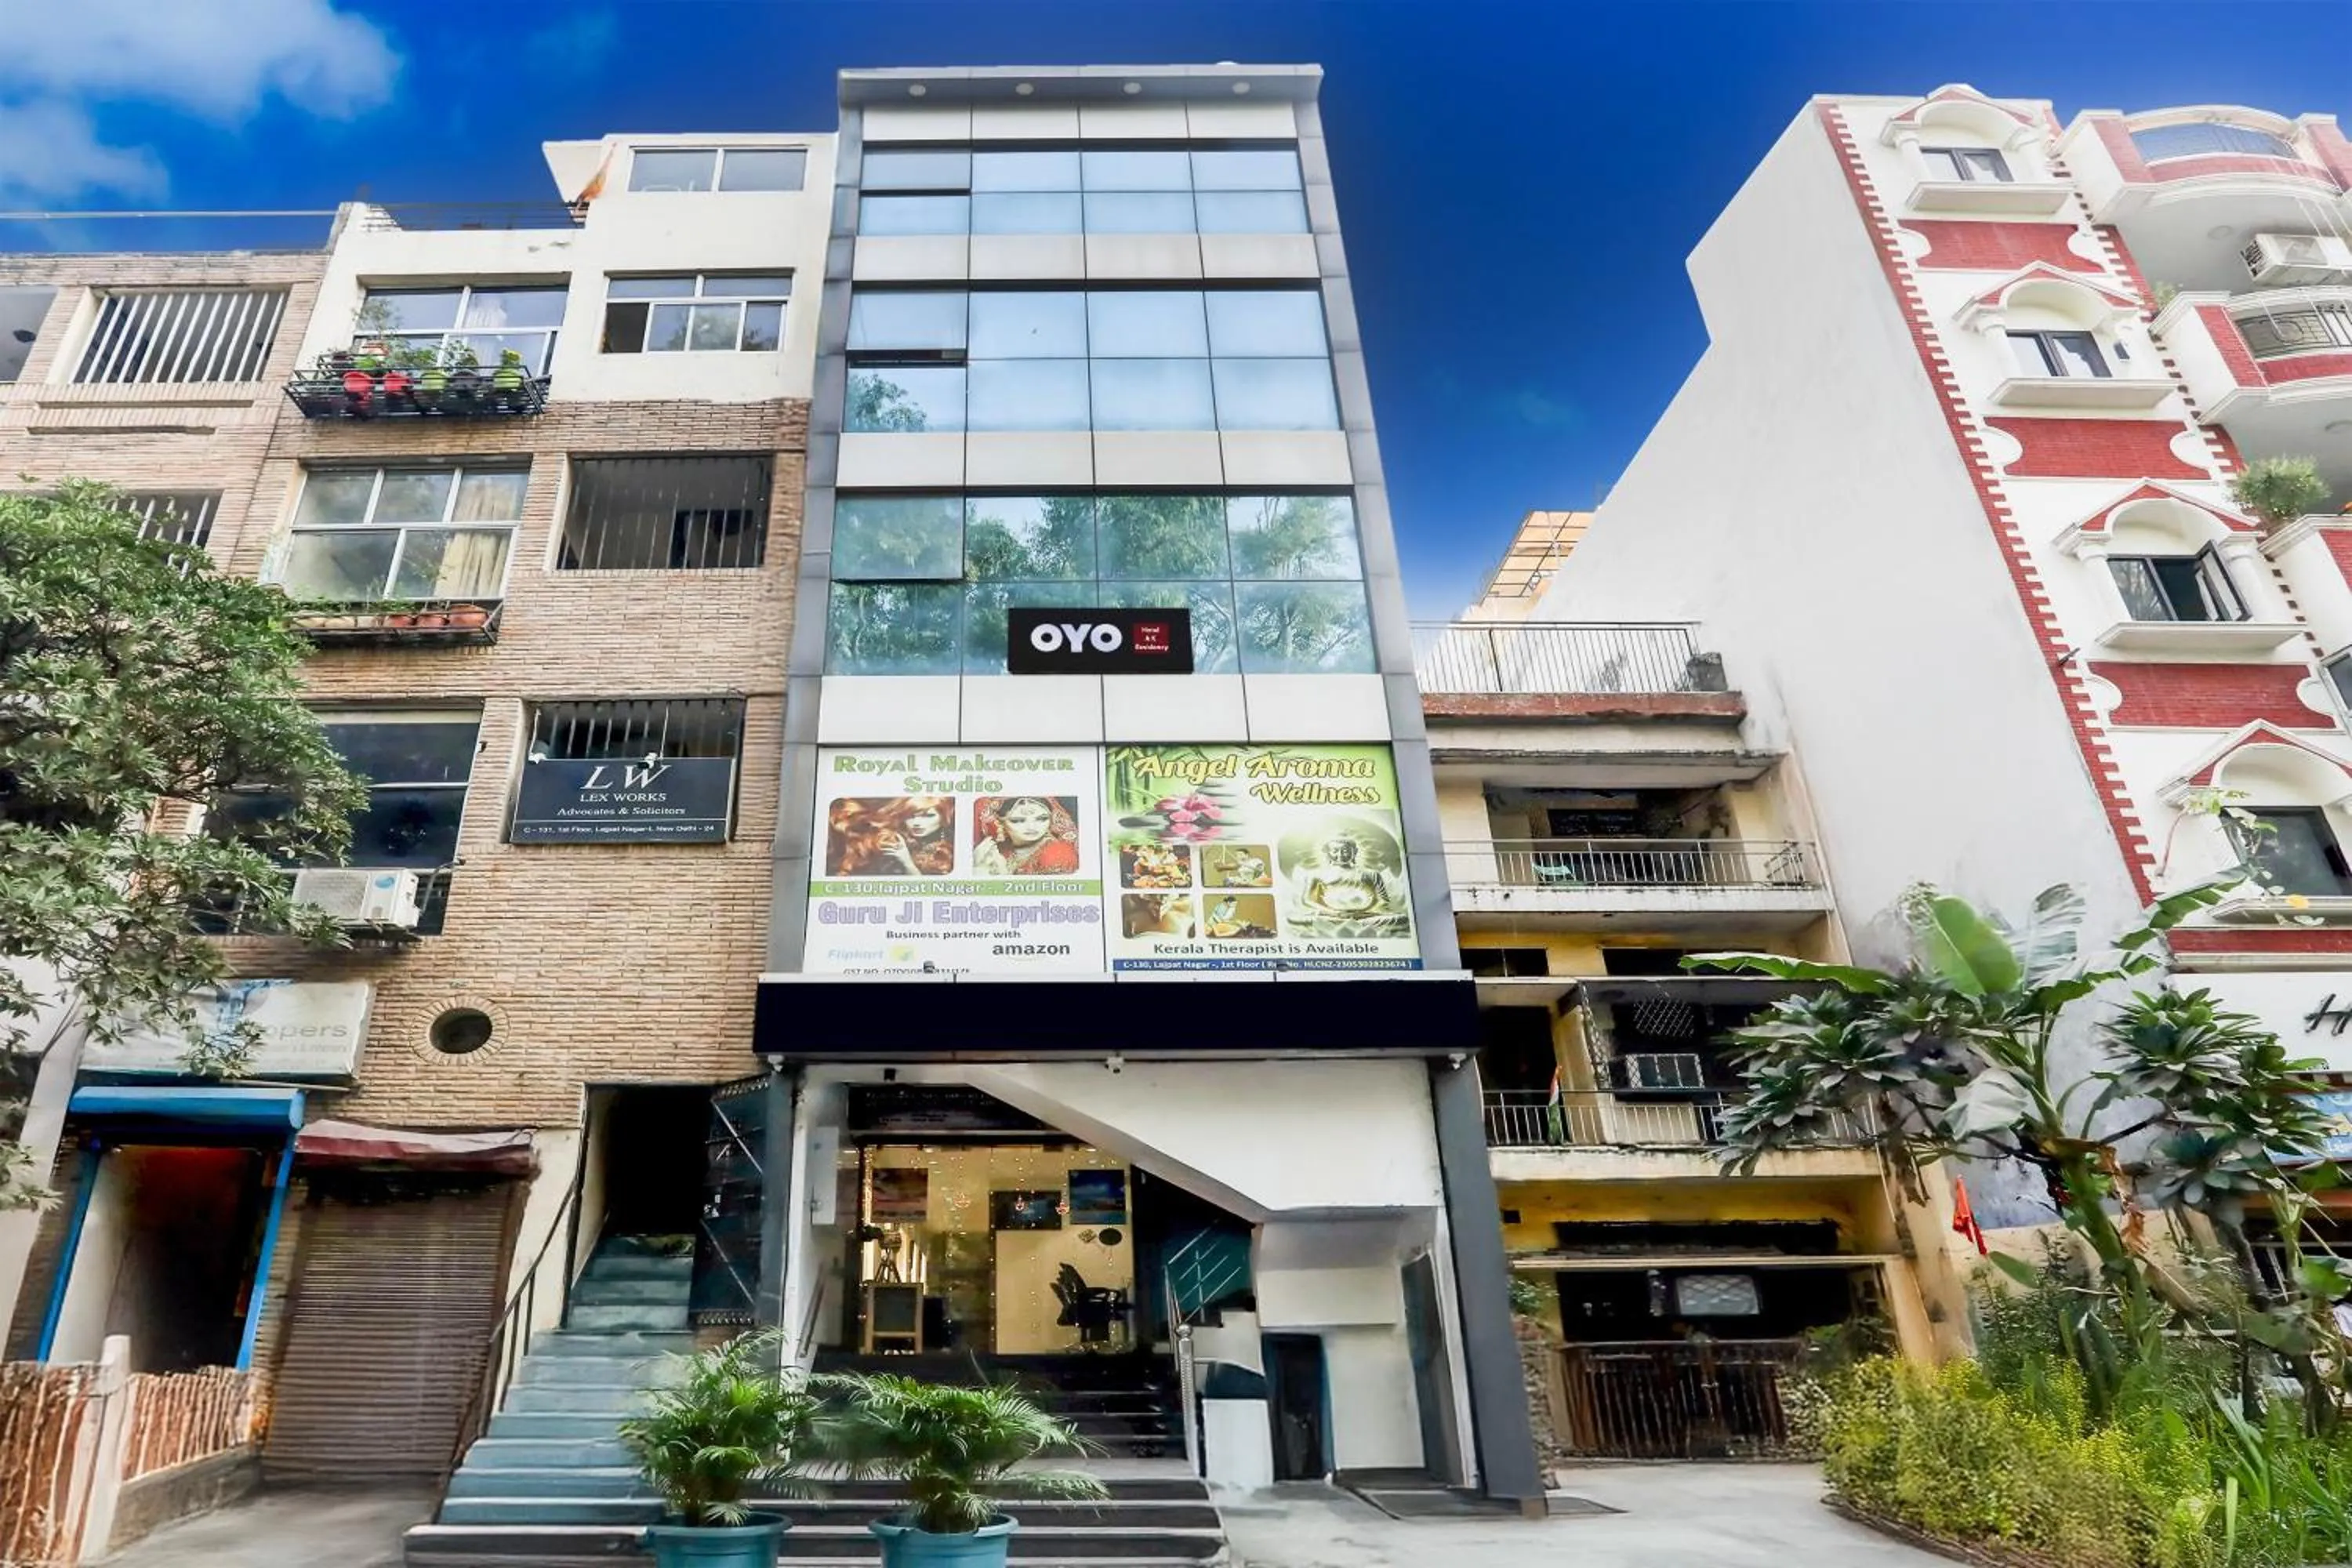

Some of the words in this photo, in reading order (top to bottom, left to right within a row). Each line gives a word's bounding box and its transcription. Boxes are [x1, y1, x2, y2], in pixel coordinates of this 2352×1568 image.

[1030, 623, 1122, 652] OYO
[1133, 753, 1238, 785] Angel
[1245, 751, 1375, 778] Aroma
[580, 765, 614, 789] L
[580, 793, 608, 802] LEX
[614, 793, 667, 802] WORKS
[1250, 782, 1380, 804] Wellness
[557, 807, 615, 816] Advocates
[619, 807, 629, 815] &
[633, 806, 686, 815] Solicitors
[932, 882, 980, 895] Nagar
[1004, 882, 1036, 893] 2nd
[1041, 881, 1084, 892] Floor
[818, 901, 887, 924] Guru
[932, 901, 1100, 928] Enterprises
[887, 930, 940, 939] Business
[943, 930, 989, 941] partner
[993, 930, 1022, 939] with
[992, 944, 1071, 956] amazon
[1153, 943, 1204, 954] Kerala
[1209, 942, 1283, 956] Therapist
[1288, 942, 1301, 954] is
[1305, 942, 1380, 954] Available
[1236, 960, 1259, 969] Floor
